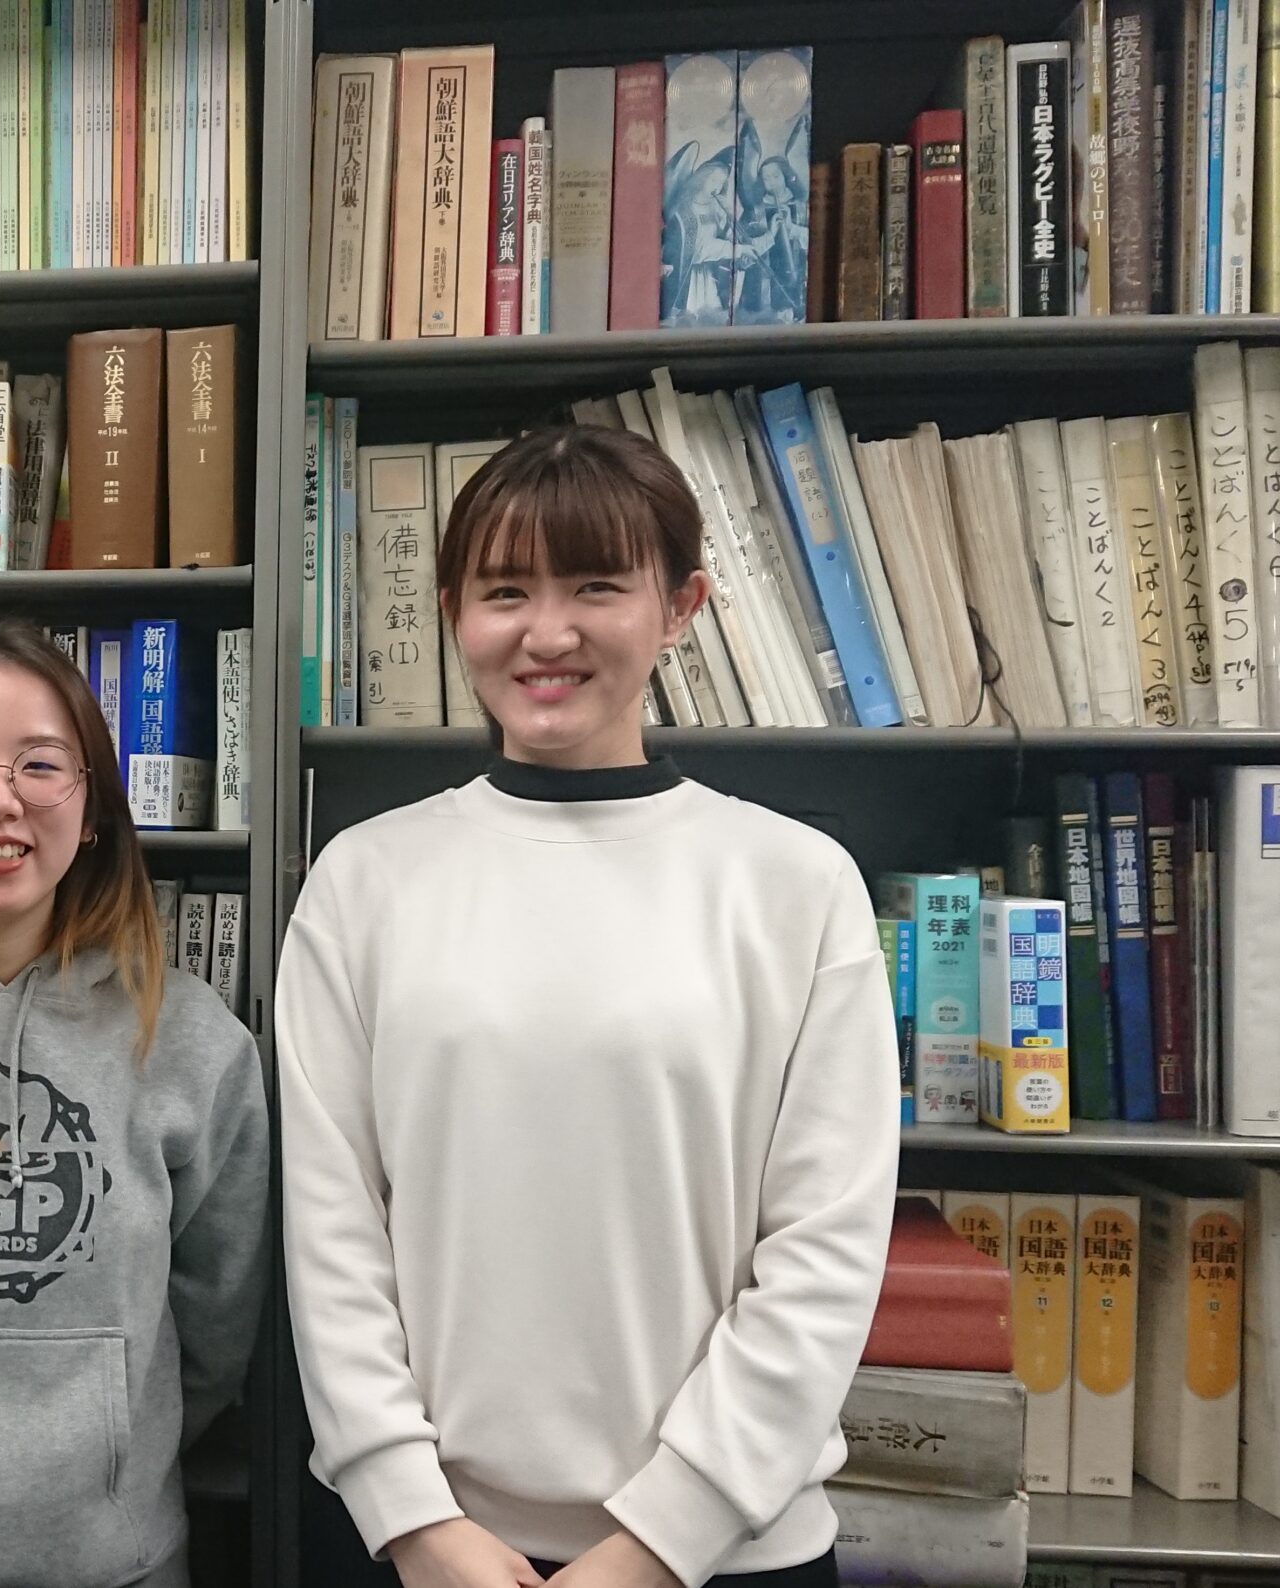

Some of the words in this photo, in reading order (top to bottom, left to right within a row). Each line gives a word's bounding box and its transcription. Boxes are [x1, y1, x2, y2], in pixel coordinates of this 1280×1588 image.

[340, 81, 365, 208] 朝鮮語大辞典
[432, 78, 457, 210] 朝鮮語大辞典
[526, 129, 543, 224] 韓国姓名字典
[1033, 105, 1055, 259] 日本ラグビー全史
[1089, 135, 1105, 236] 故郷のヒーロー
[498, 153, 517, 262] 在日コリアン辞典
[104, 346, 125, 423] 六法全書
[192, 342, 213, 420] 六法全書
[223, 634, 241, 800] 日本語使いさばき辞典
[1068, 828, 1092, 921] 日本地図帳
[1114, 829, 1140, 923] 世界地図帳
[928, 895, 971, 913] 理科
[218, 904, 238, 990] 読めば読むほど
[928, 919, 971, 936] 年表
[932, 942, 965, 951] 2021
[1037, 935, 1061, 980] 明鏡
[1012, 935, 1036, 1028] 国語辞典
[1013, 1054, 1064, 1069] 最新版
[1020, 1237, 1068, 1259] 国語
[1029, 1220, 1057, 1233] 日本
[1084, 1238, 1133, 1260] 国語
[1094, 1221, 1122, 1235] 日本
[1202, 1224, 1228, 1237] 日本
[1020, 1262, 1066, 1275] 大辞典
[1086, 1263, 1132, 1277] 大辞典
[1192, 1242, 1237, 1264] 国語
[1194, 1267, 1236, 1280] 大辞典
